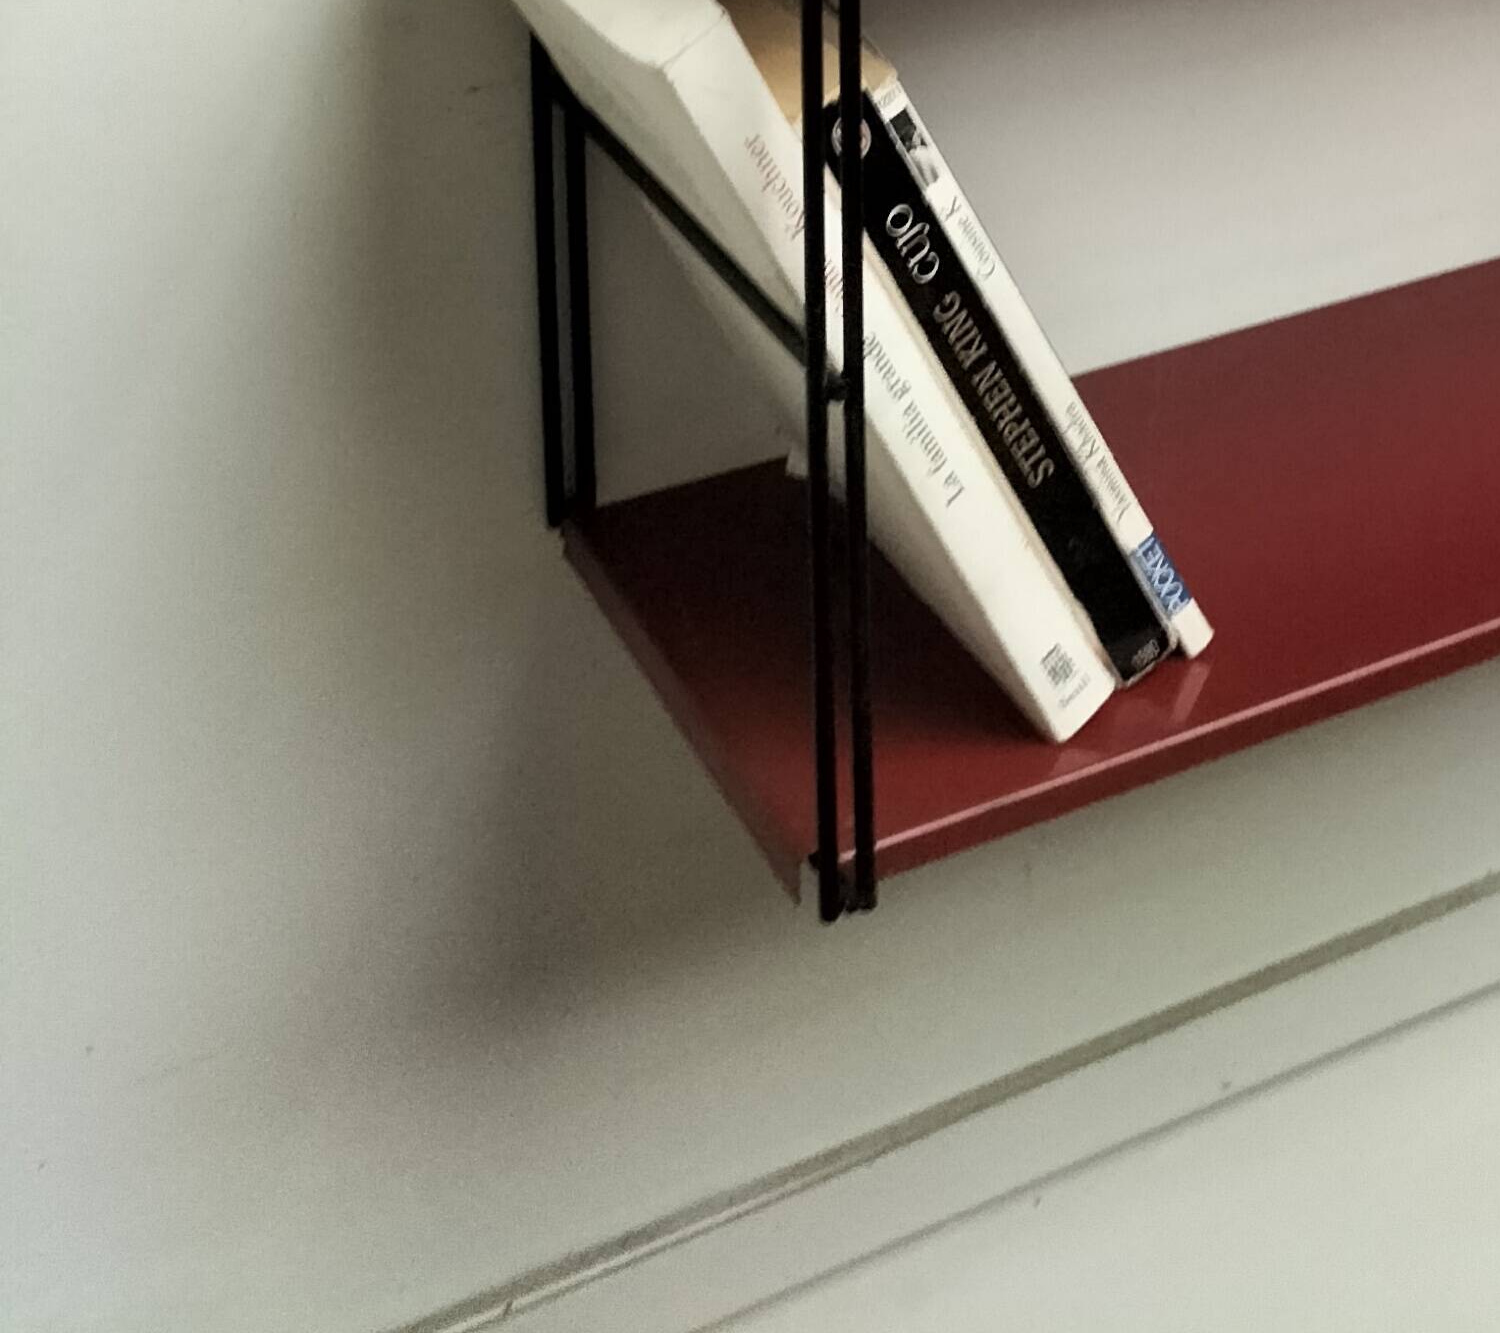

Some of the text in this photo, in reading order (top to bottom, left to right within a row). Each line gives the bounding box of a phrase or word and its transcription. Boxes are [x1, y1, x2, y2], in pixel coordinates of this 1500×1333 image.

[941, 195, 962, 223] K
[957, 216, 996, 280] Cousine
[933, 290, 989, 371] KING
[861, 331, 966, 509] La familia grande
[971, 359, 1055, 490] STEPHEN
[1096, 455, 1132, 525] Yasmina
[1136, 536, 1190, 614] POCKET
